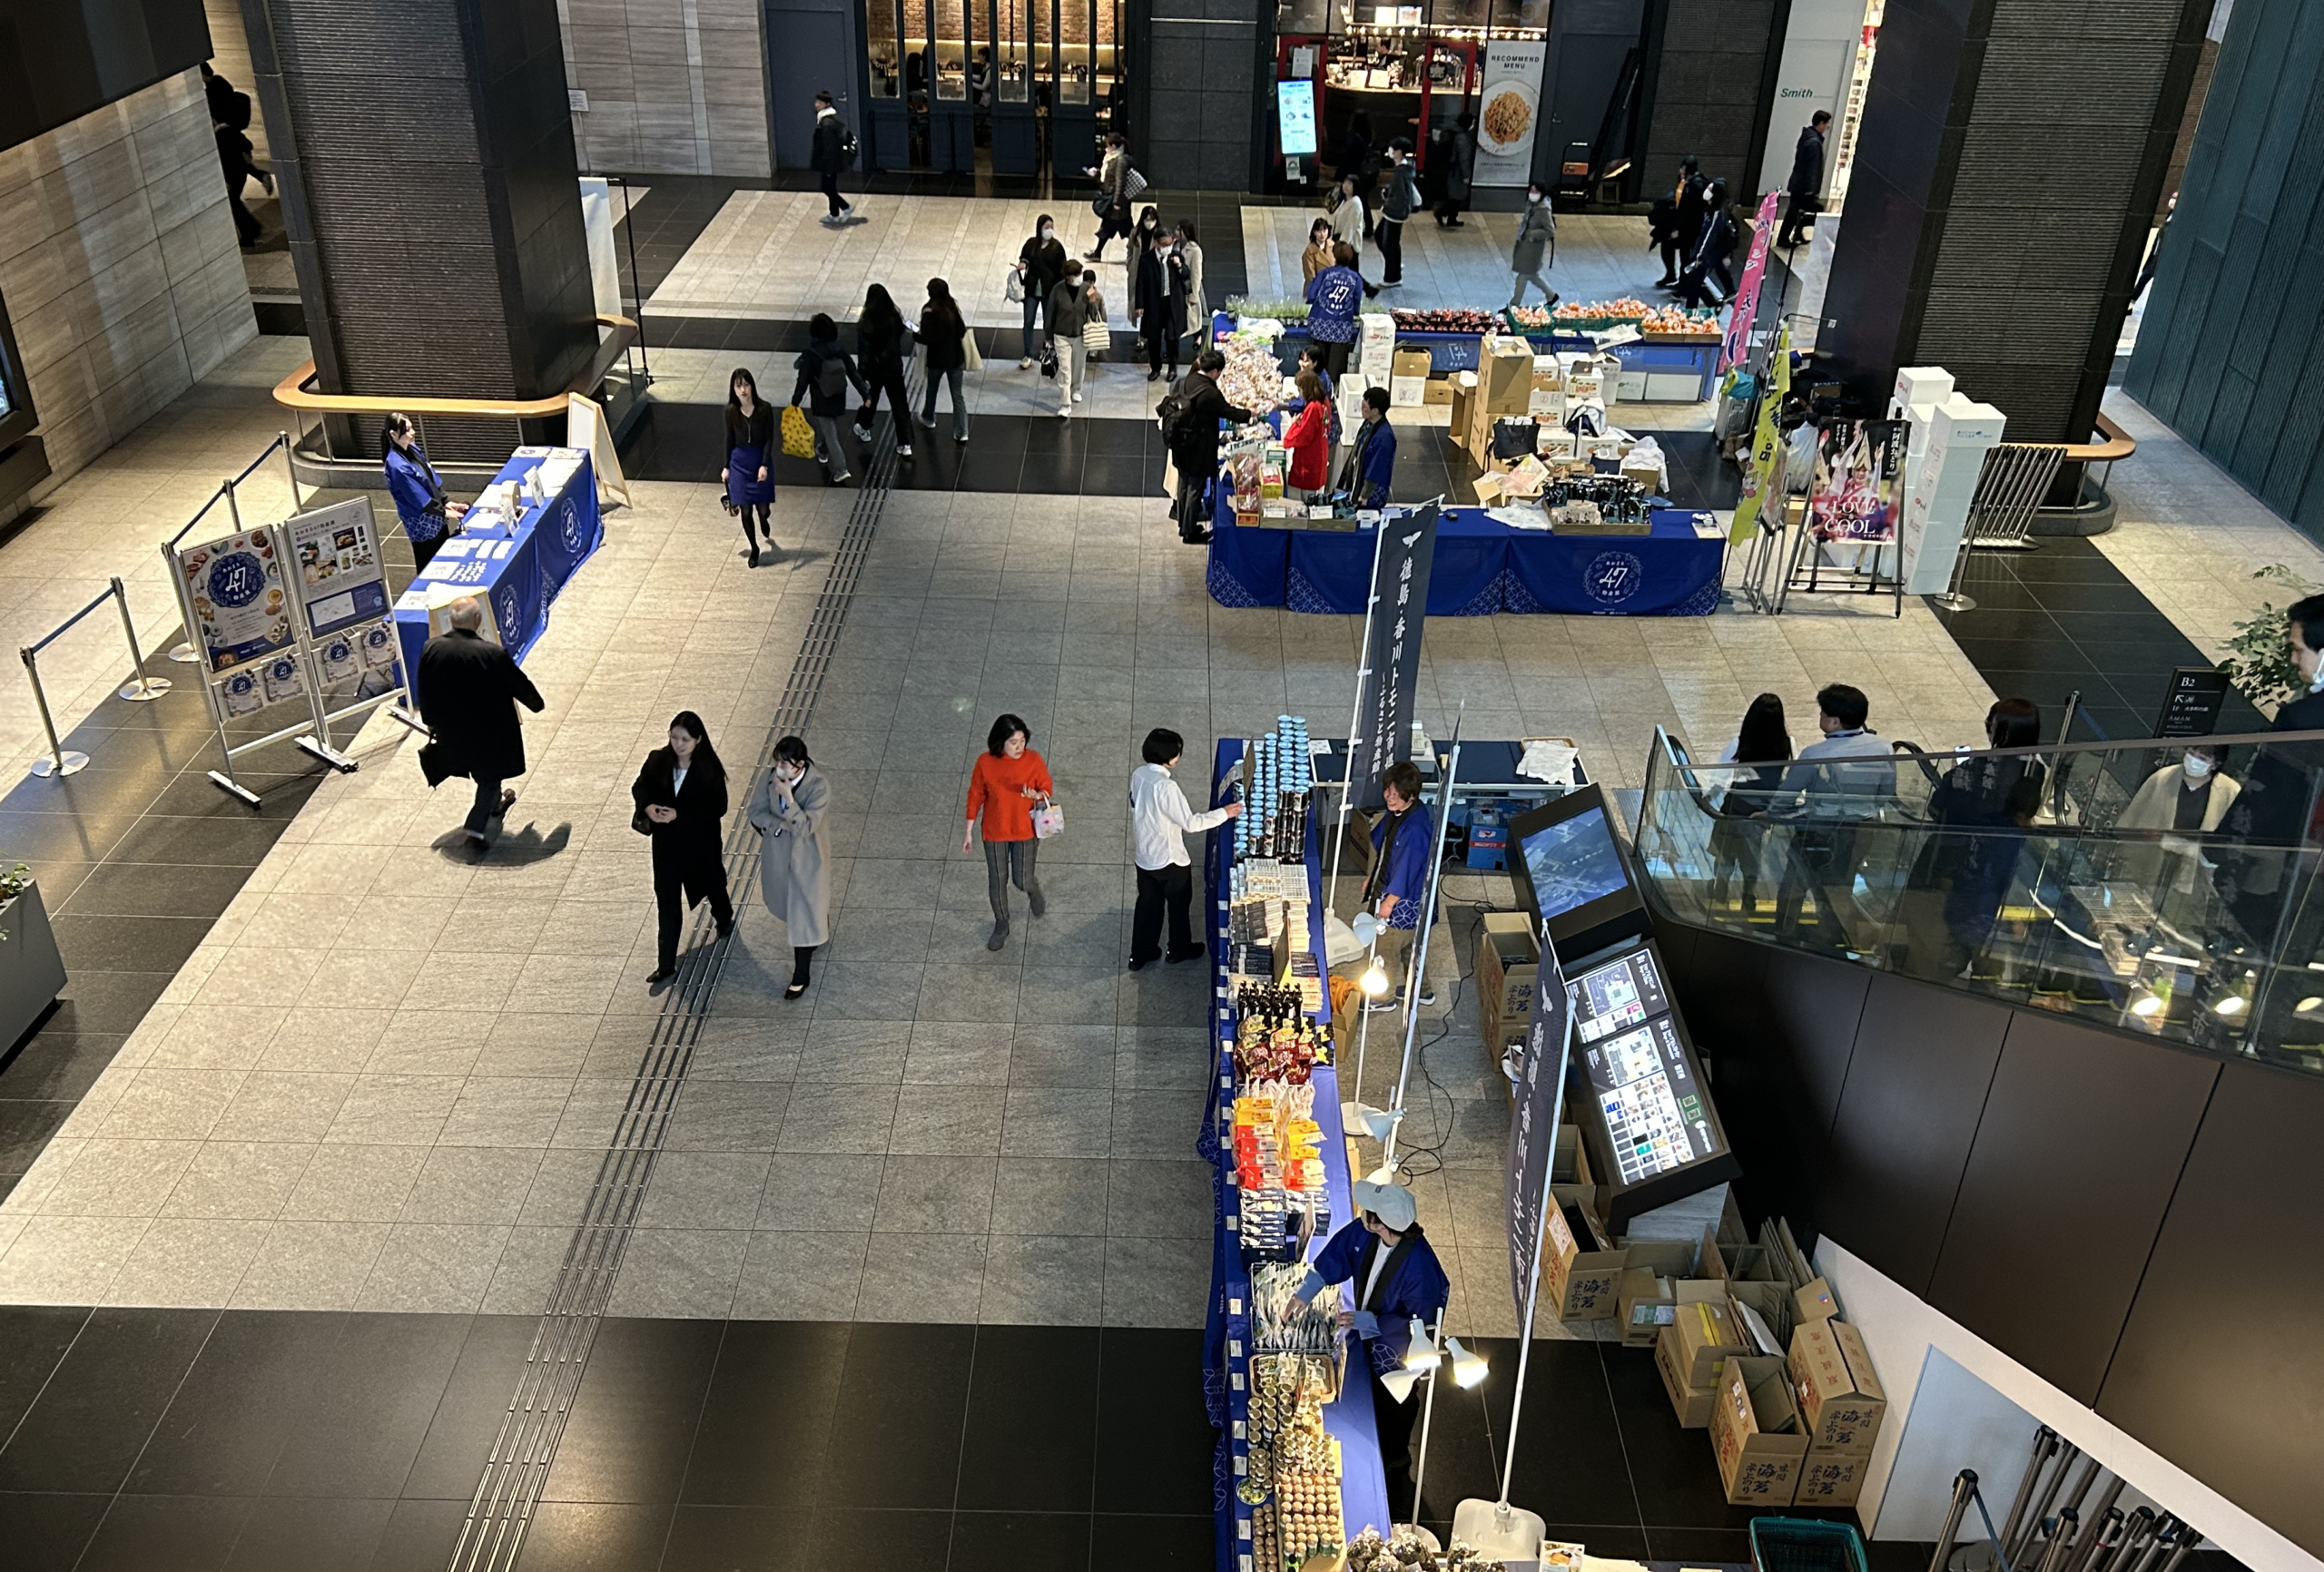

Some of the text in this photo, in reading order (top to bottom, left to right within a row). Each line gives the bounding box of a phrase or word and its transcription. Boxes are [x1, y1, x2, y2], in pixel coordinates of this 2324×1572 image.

[1492, 54, 1540, 63] RECOMMEND
[1780, 87, 1814, 98] Smith
[1328, 285, 1350, 303] 47
[1832, 501, 1876, 515] LOVE
[1825, 518, 1876, 534] COOL
[225, 566, 247, 592] 47
[1599, 567, 1629, 589] 47
[2181, 676, 2196, 687] B2
